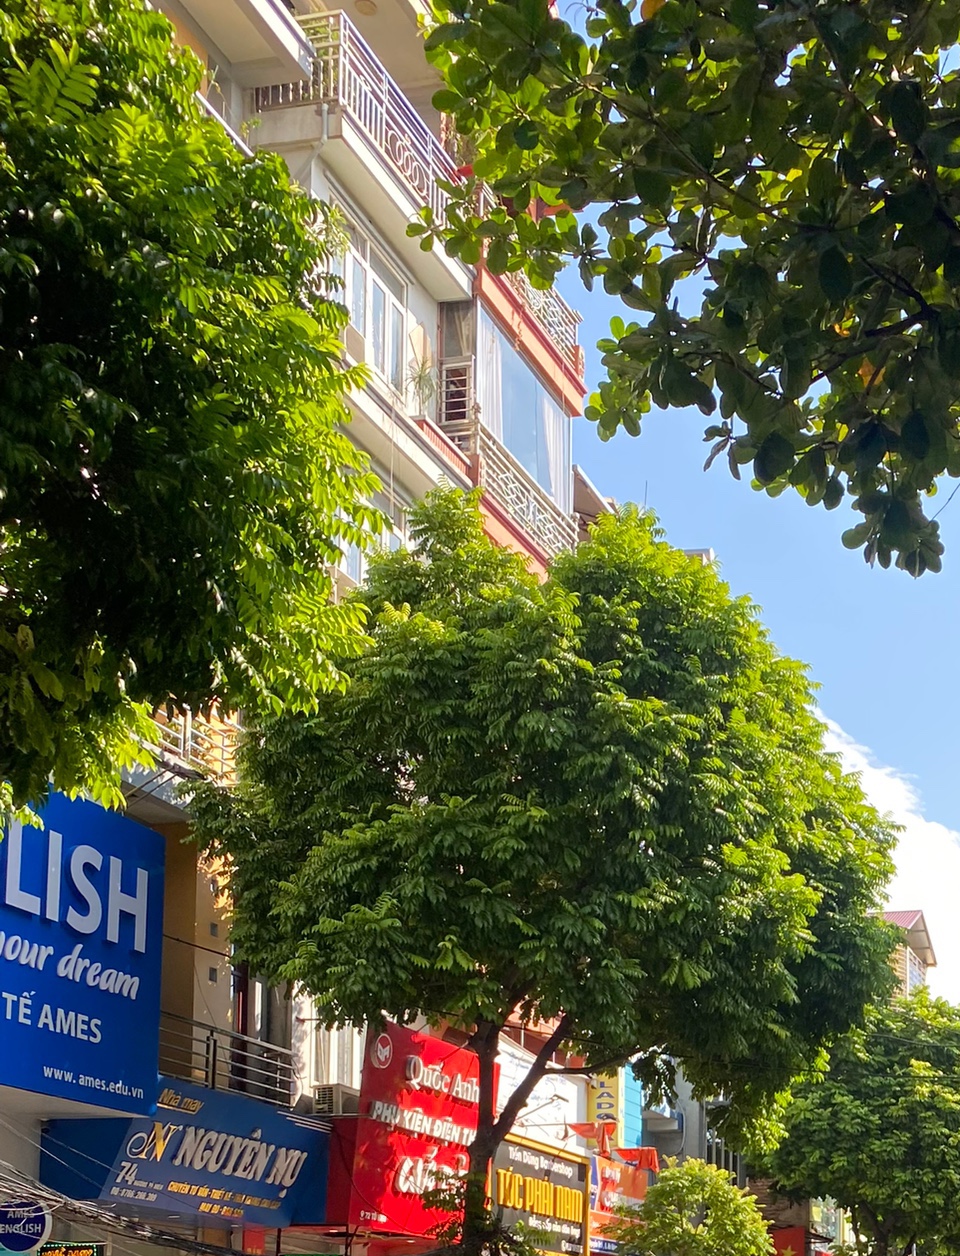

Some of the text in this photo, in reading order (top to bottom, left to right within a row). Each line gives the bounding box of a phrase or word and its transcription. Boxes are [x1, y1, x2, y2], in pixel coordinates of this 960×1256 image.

[6, 815, 149, 954] LISH
[56, 943, 141, 1001] dream
[2, 991, 102, 1044] TẾ AMES
[406, 1055, 480, 1104] Quốc Anh
[371, 1101, 401, 1131] PHỤ
[402, 1107, 432, 1139] KIỆN
[433, 1115, 461, 1146] ĐIỆN
[115, 1161, 139, 1185] 74
[173, 1128, 276, 1182] NGUYÊN
[265, 1147, 308, 1199] NỤ
[523, 1175, 555, 1217] PHÁI
[553, 1184, 583, 1224] NAM
[0, 1223, 42, 1234] ENGLISH
